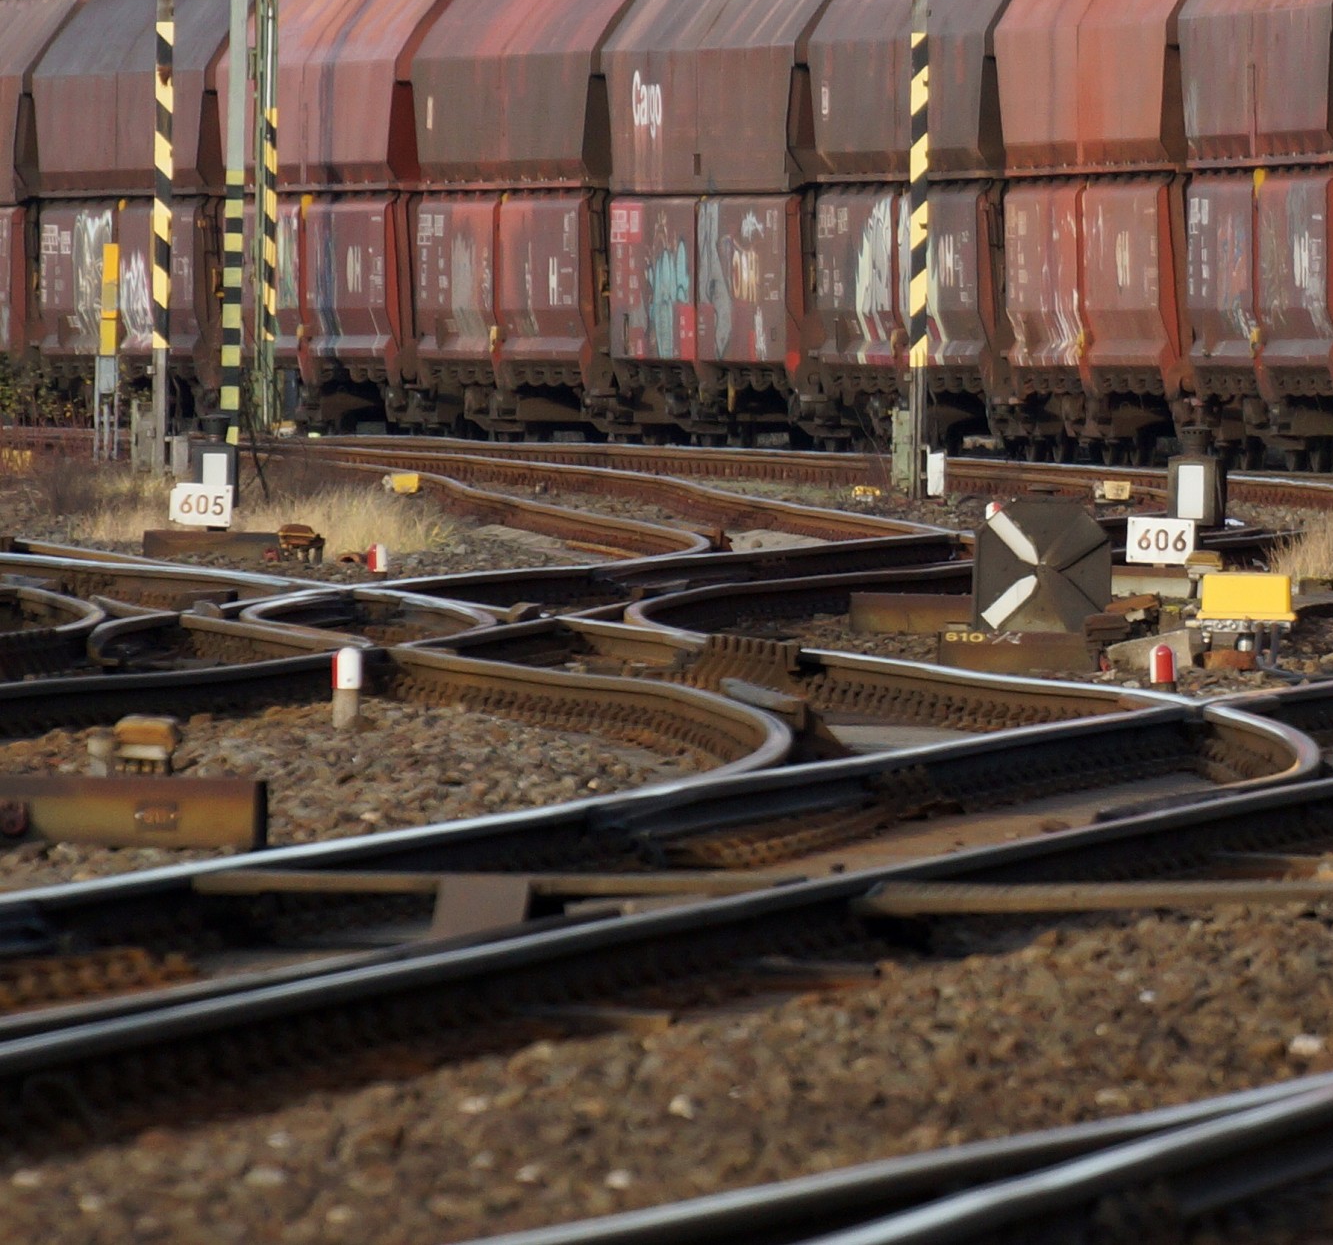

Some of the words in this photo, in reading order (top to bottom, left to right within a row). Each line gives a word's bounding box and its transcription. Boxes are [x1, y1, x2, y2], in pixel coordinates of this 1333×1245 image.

[632, 69, 663, 140] Cargo
[179, 493, 225, 516] 605
[1137, 528, 1187, 552] 606
